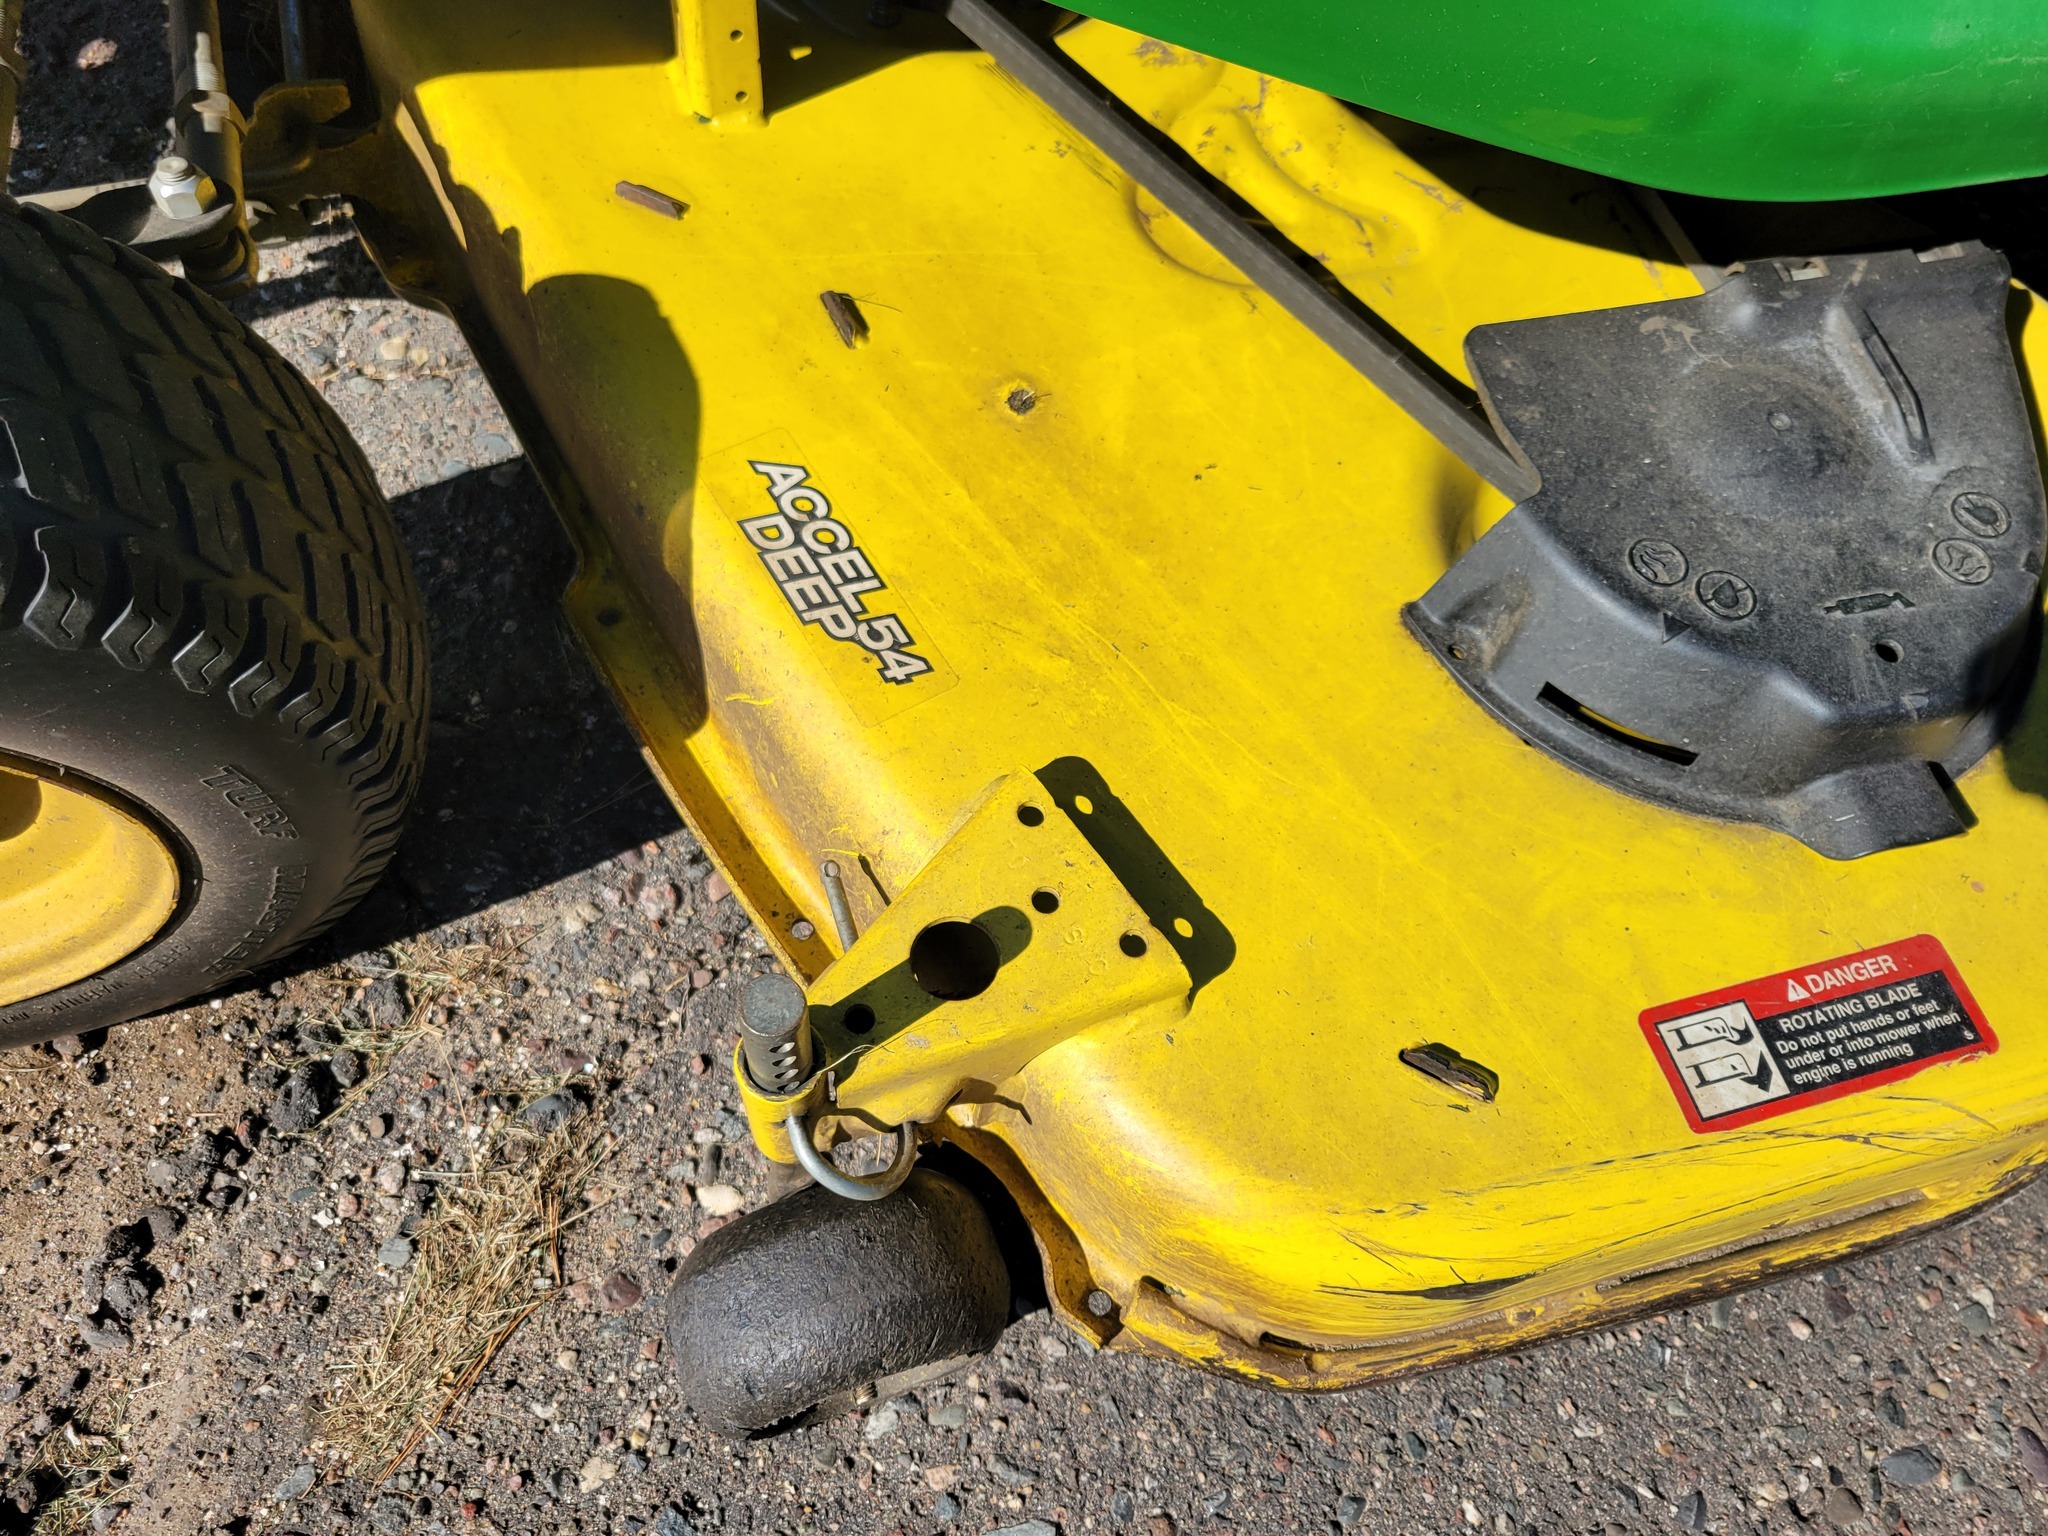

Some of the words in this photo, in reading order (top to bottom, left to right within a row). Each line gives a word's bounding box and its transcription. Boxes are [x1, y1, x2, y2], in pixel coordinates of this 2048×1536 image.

[737, 512, 858, 642] DEEP
[747, 460, 888, 616] ACCEL
[856, 612, 935, 686] 54
[201, 764, 300, 839] TURF
[1804, 954, 1899, 994] DANGER
[1775, 1039, 1799, 1055] Do
[1800, 1031, 1826, 1048] not
[1825, 1024, 1852, 1045] put
[1850, 1013, 1895, 1035] hands
[1895, 1009, 1912, 1022] or
[1911, 999, 1942, 1017] feet
[1778, 1000, 1865, 1034] ROTATING
[1864, 982, 1923, 1010] BLADE
[1784, 1049, 1826, 1070] under
[1828, 1045, 1844, 1059] or
[1846, 1035, 1876, 1053] into
[1876, 1023, 1922, 1044] mower
[1922, 1011, 1962, 1031] when
[1793, 1062, 1842, 1085] engine
[1842, 1058, 1858, 1073] is
[1858, 1042, 1915, 1068] running
